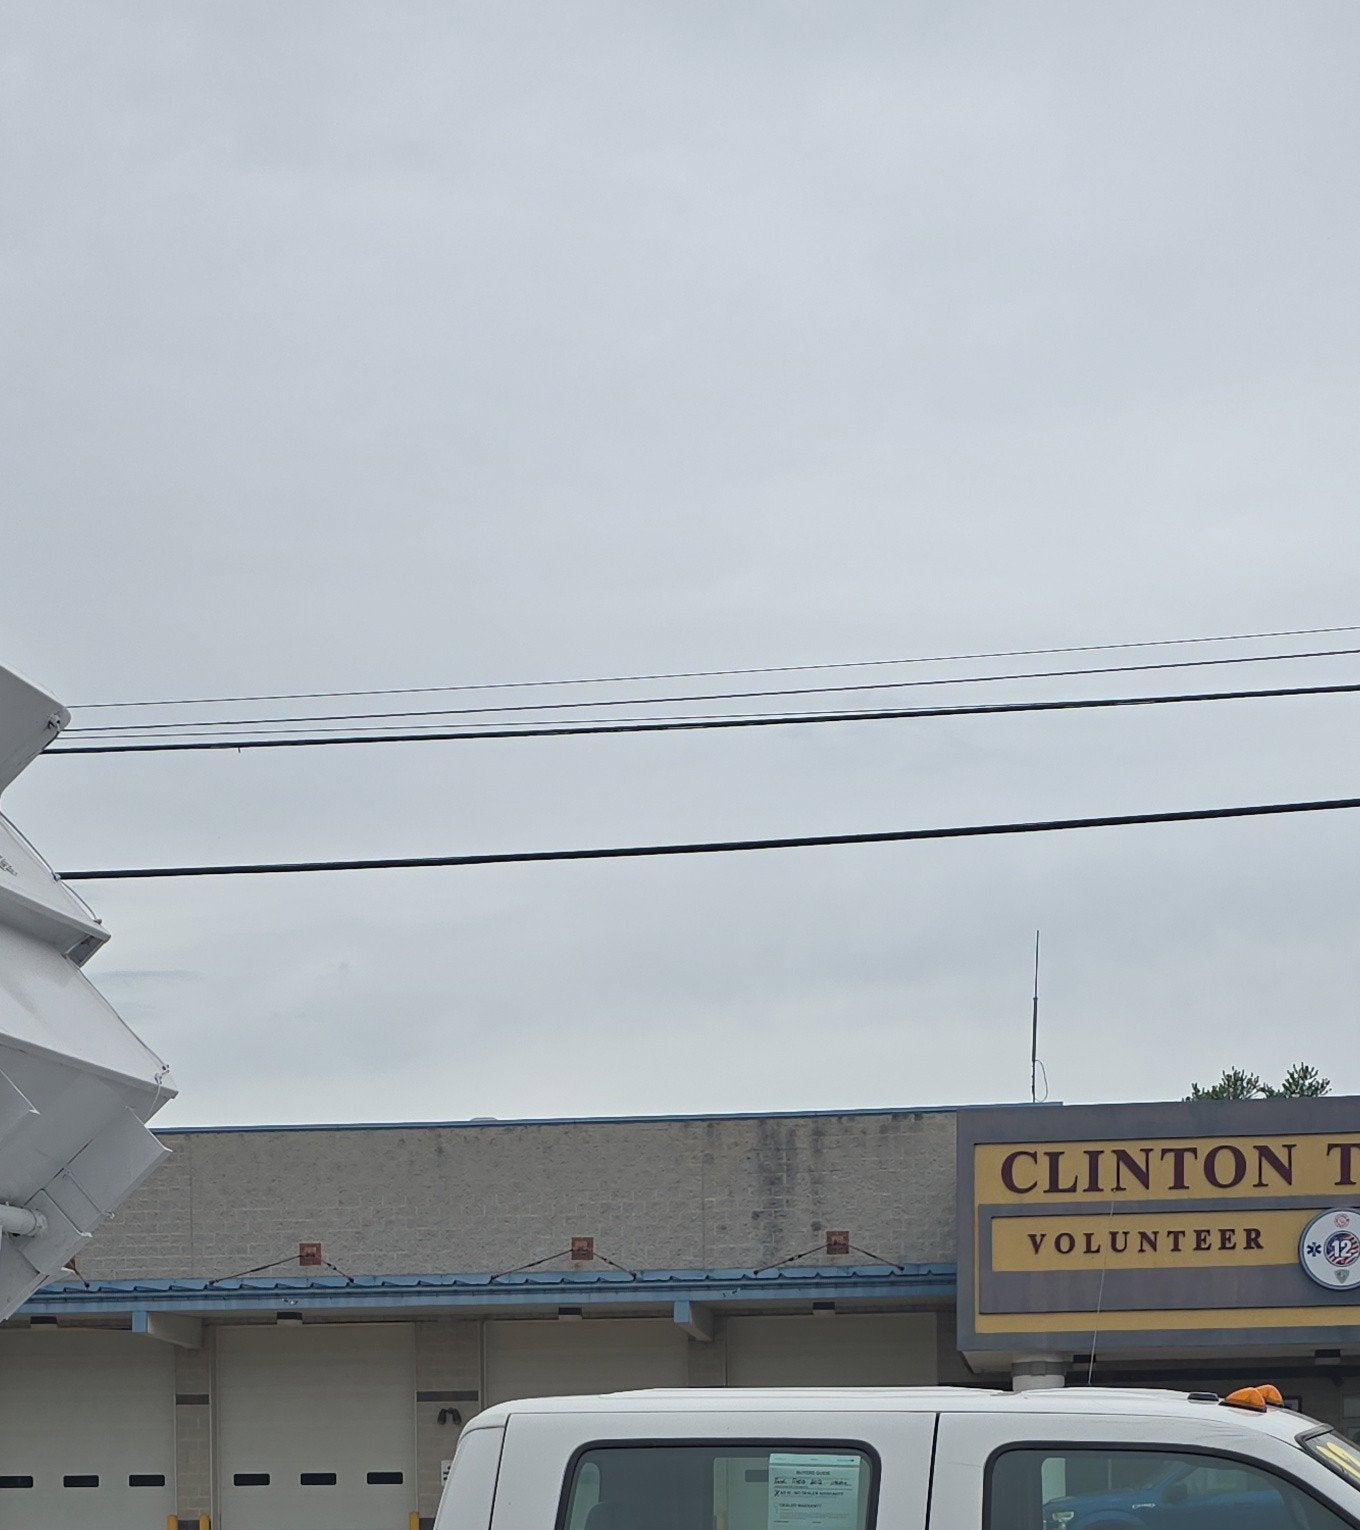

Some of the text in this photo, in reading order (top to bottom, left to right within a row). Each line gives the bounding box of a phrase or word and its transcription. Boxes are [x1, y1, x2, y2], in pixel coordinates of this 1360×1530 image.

[1000, 1143, 1297, 1194] CLINTON
[1027, 1228, 1265, 1255] VOLUNTEER
[1331, 1240, 1352, 1258] 12
